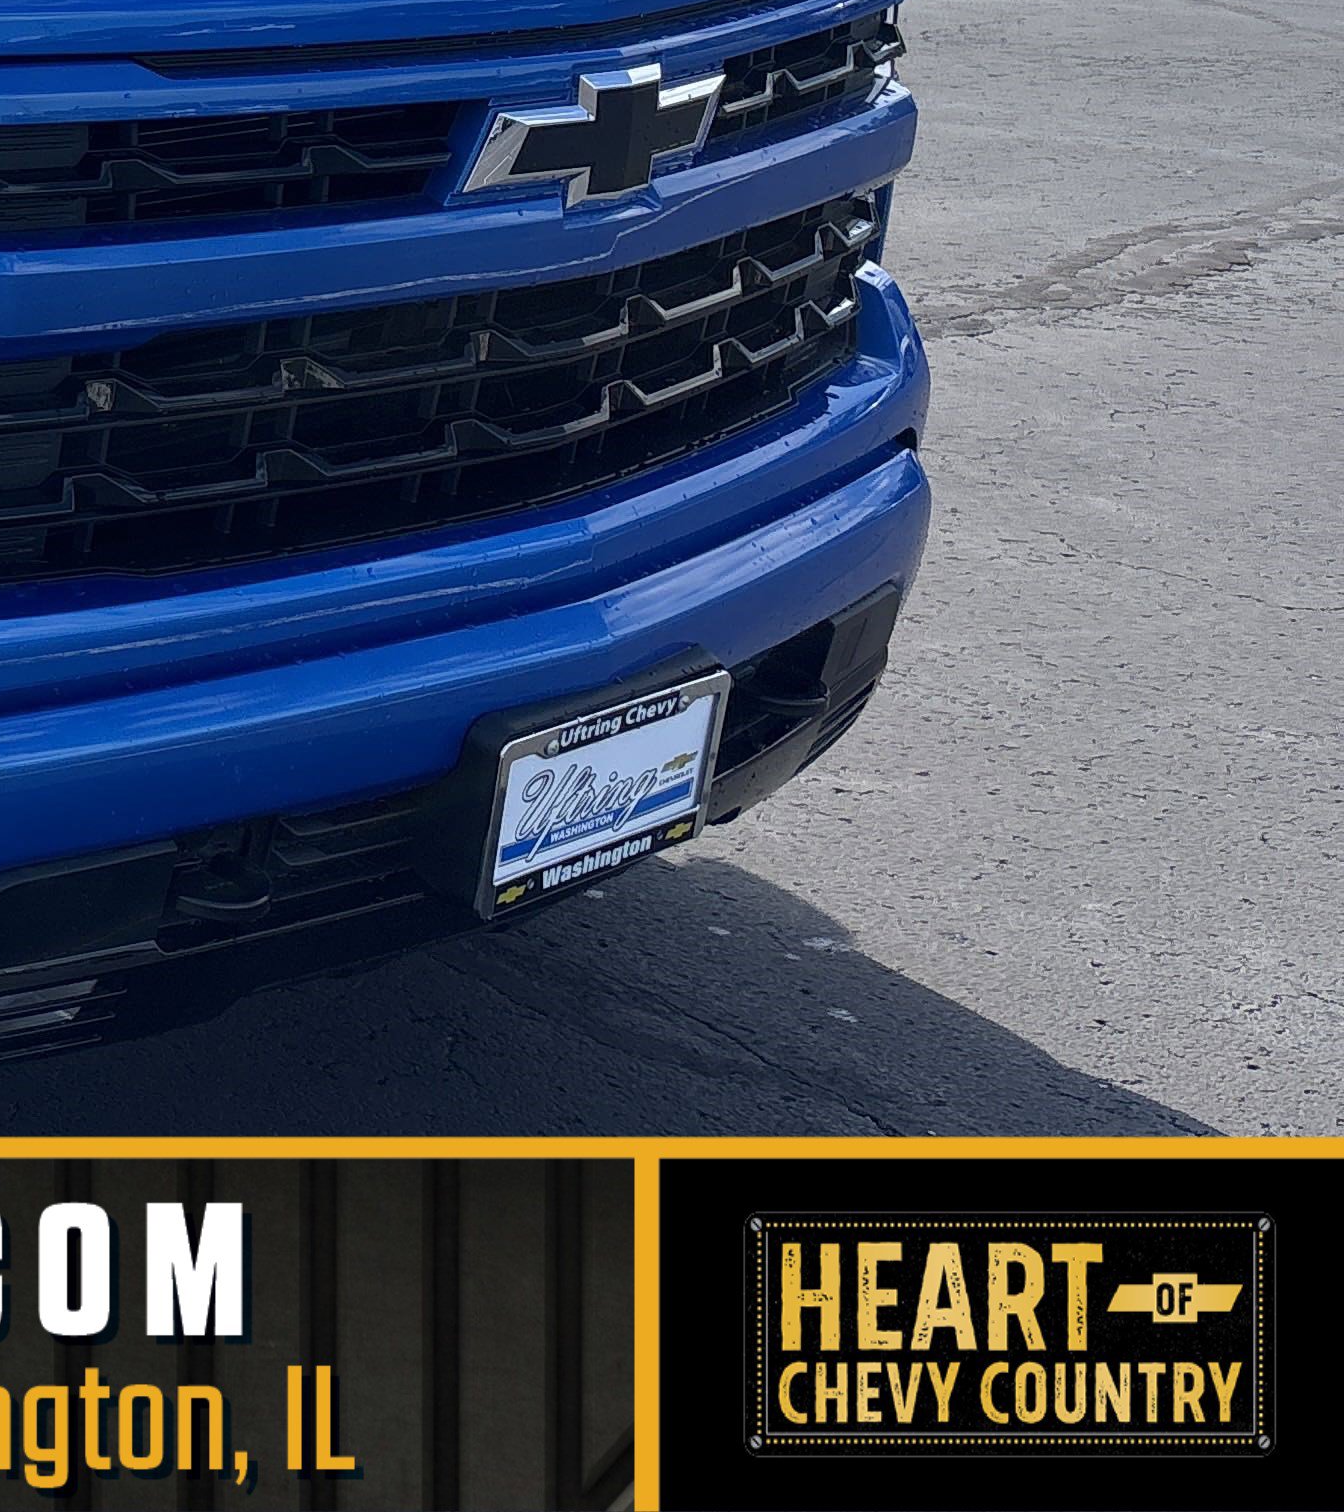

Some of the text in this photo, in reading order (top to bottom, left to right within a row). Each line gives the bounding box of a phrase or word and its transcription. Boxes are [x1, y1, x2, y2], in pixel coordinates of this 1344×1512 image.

[560, 697, 678, 747] Uftring Chevy
[515, 763, 658, 862] Uftring
[550, 814, 614, 844] WASHINGTON
[542, 835, 652, 889] Washington
